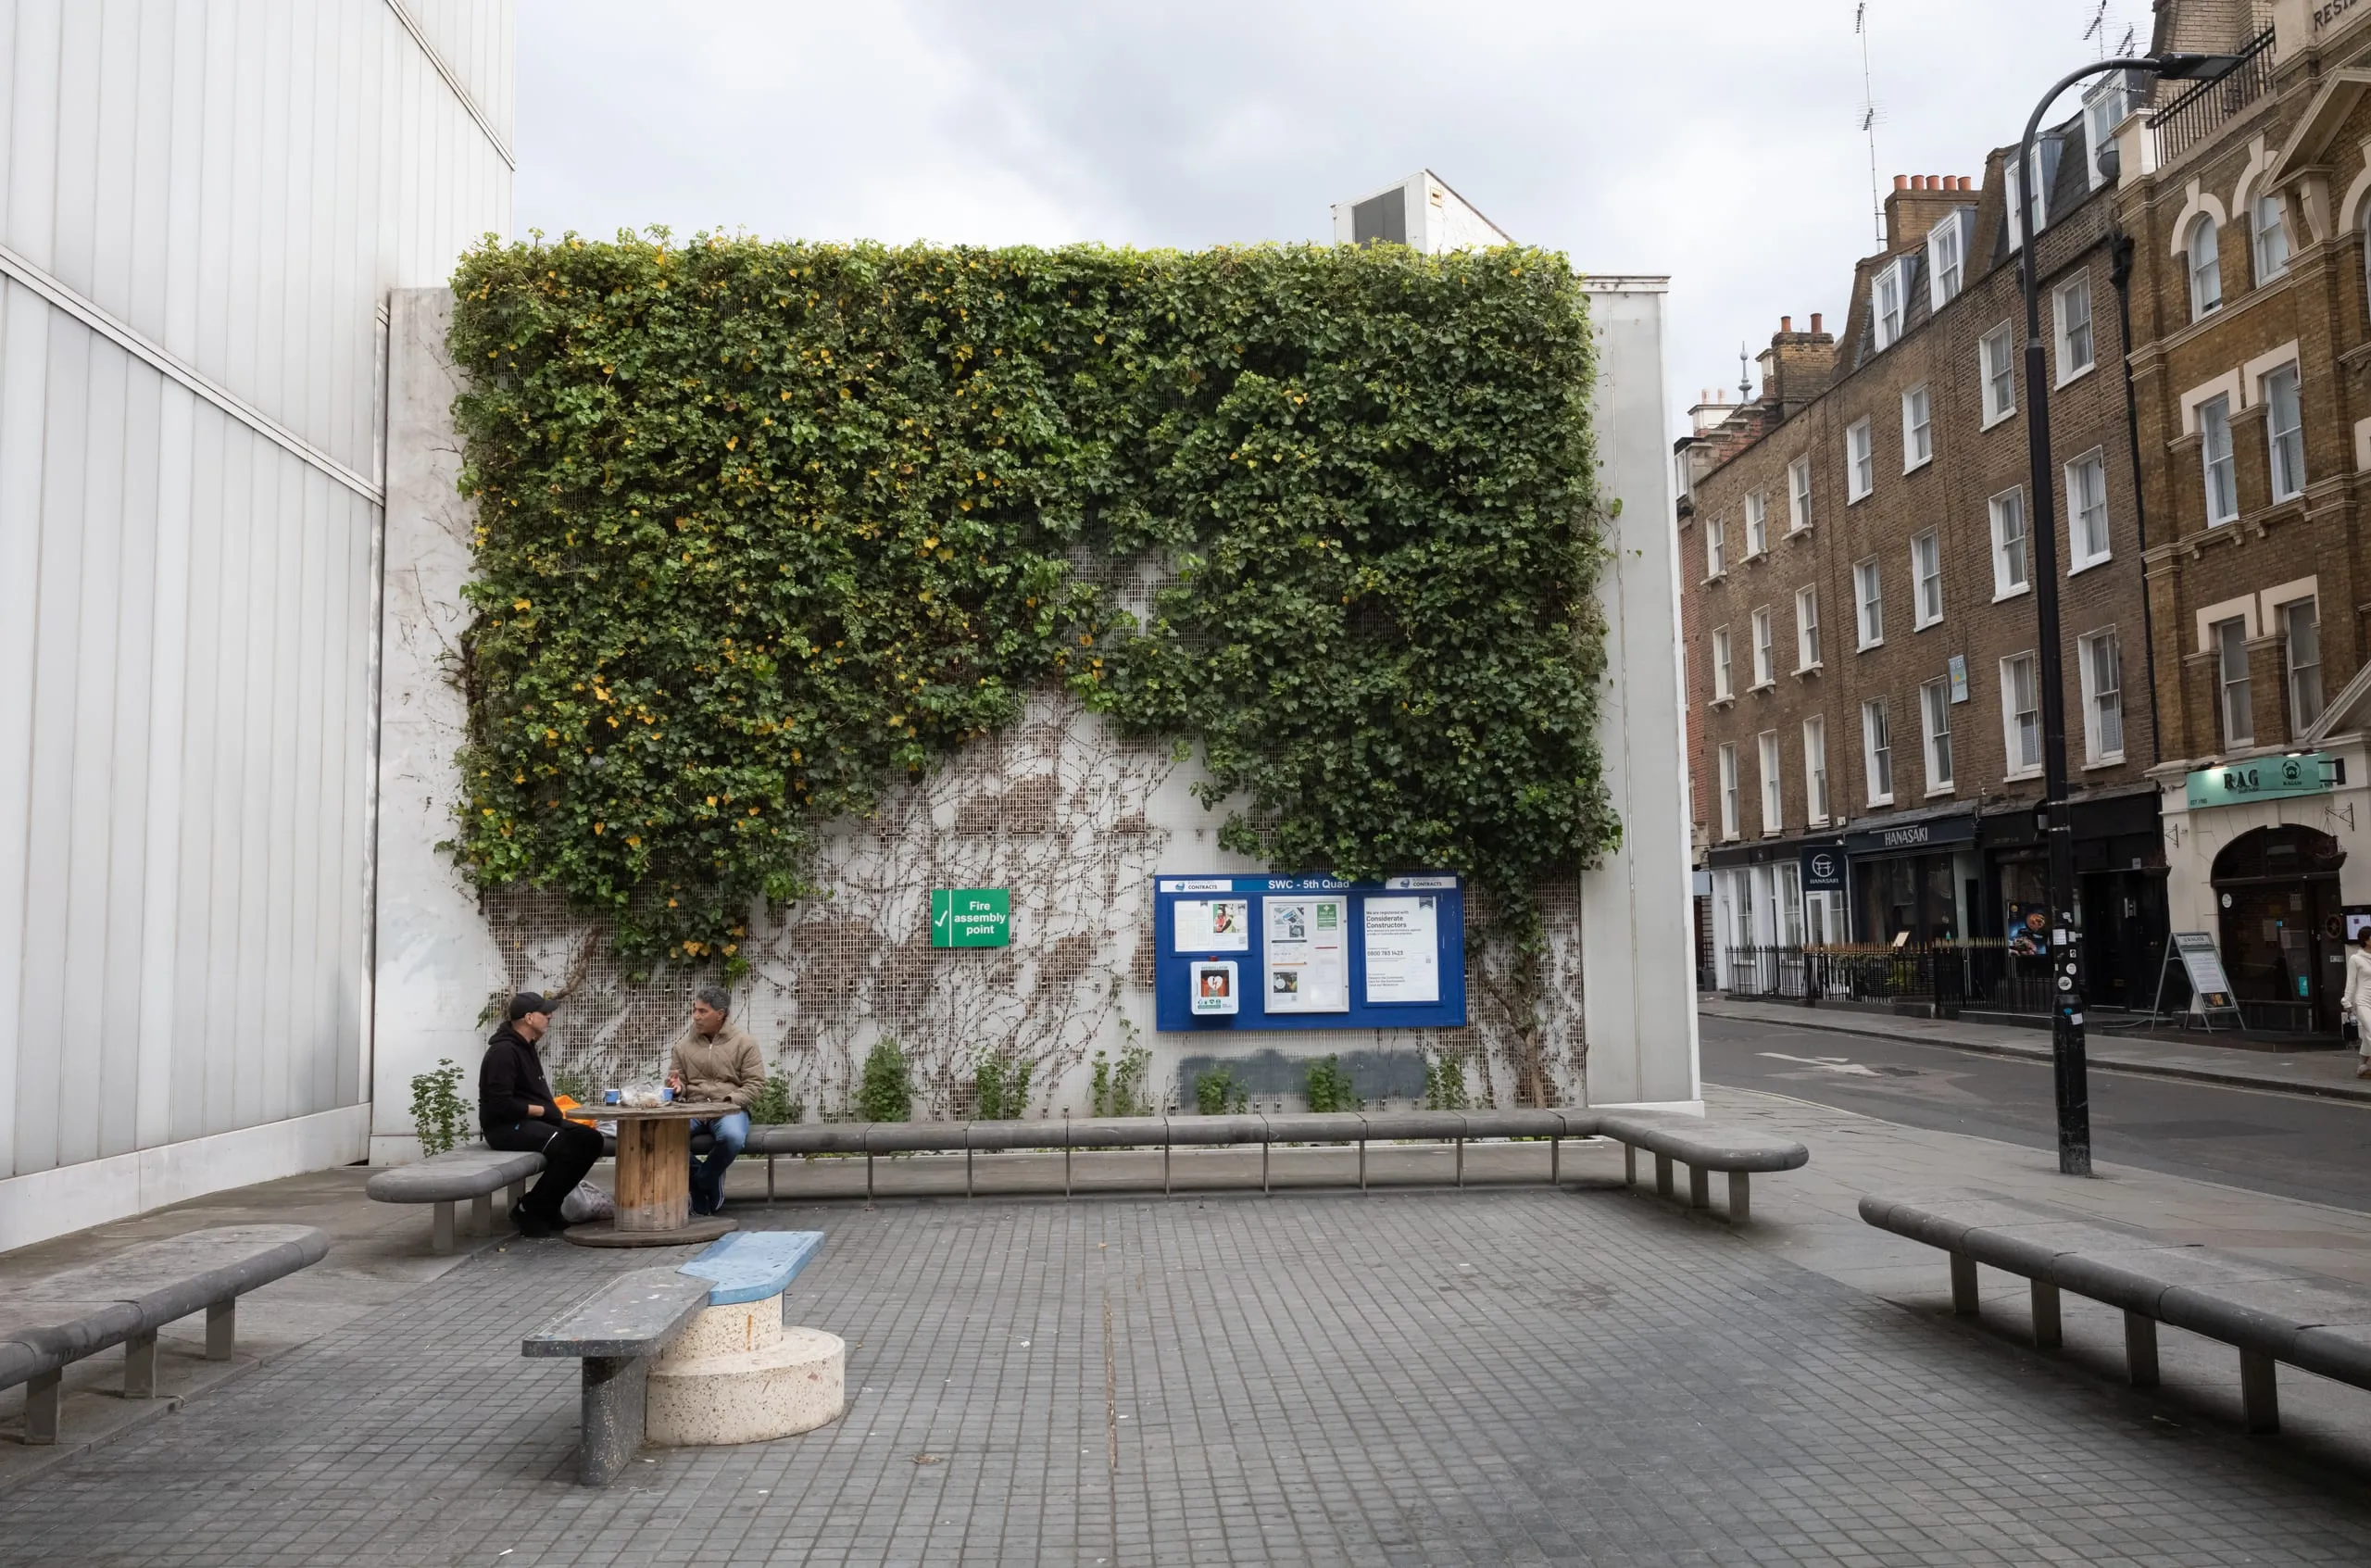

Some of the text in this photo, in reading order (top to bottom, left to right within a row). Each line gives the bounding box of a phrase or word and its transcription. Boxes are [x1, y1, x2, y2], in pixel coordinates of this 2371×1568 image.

[2314, 0, 2357, 31] RESI
[1885, 827, 1928, 847] HANASAKI
[1268, 880, 1293, 889] SWC
[1303, 880, 1319, 889] 5th
[1322, 879, 1349, 889] Quad
[970, 901, 990, 910] Fire
[954, 913, 1006, 924] assembly
[966, 925, 995, 936] point
